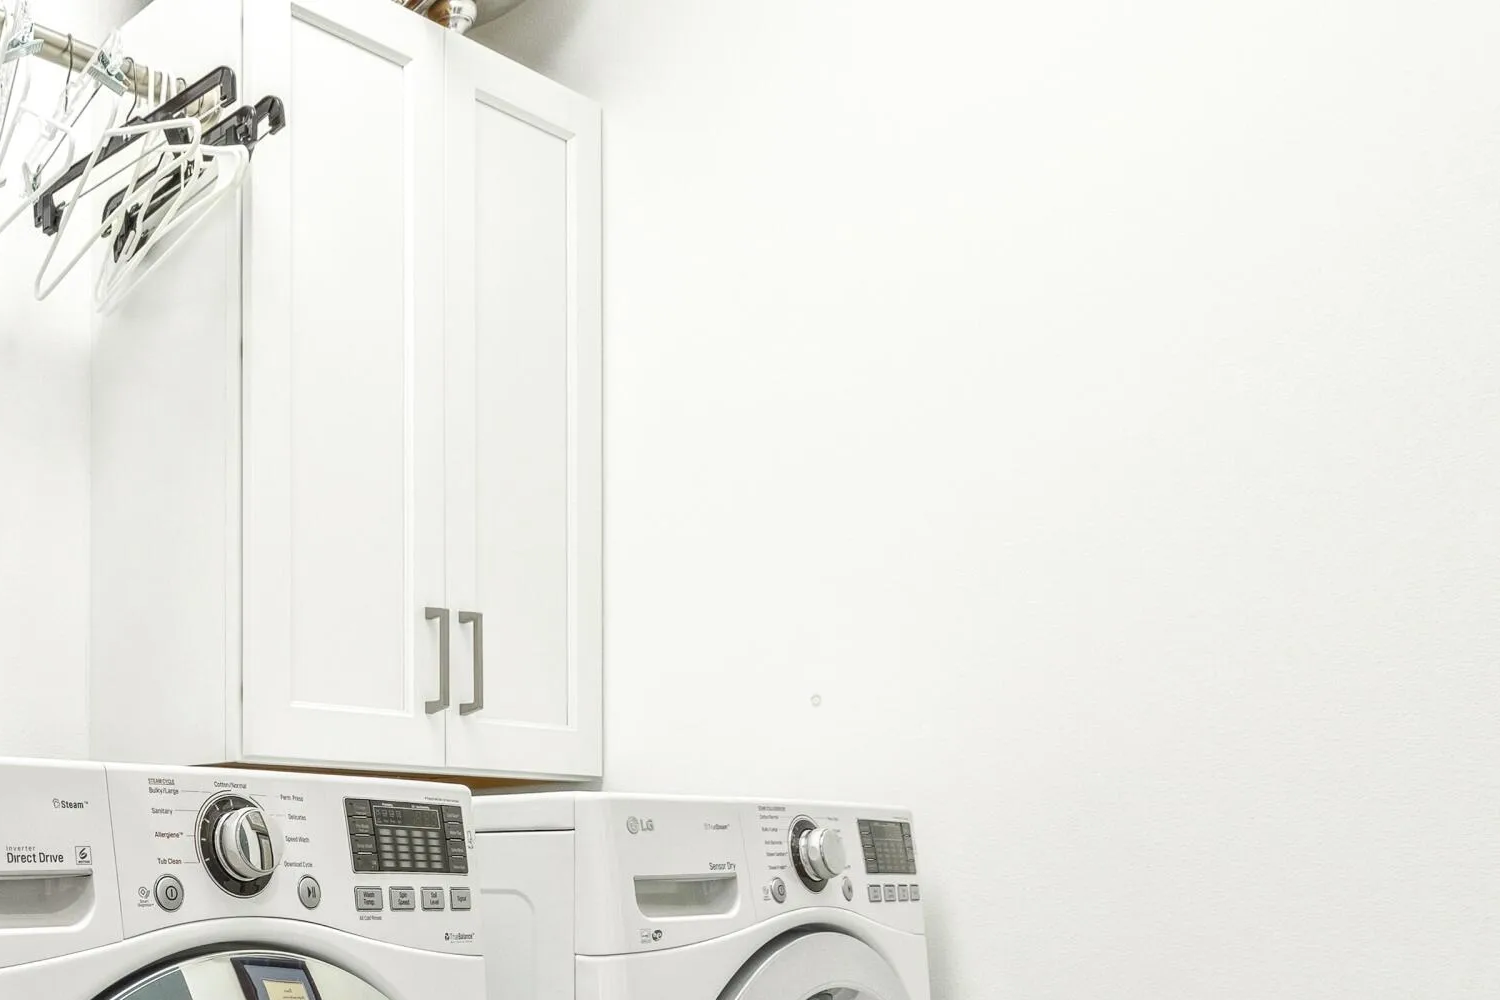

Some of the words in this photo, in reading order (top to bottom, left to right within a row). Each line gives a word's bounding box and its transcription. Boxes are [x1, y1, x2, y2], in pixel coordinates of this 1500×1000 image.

[640, 819, 654, 831] LG
[6, 852, 37, 864] Direct
[38, 852, 64, 864] Drive
[709, 862, 726, 871] Sensor
[726, 862, 736, 871] Dry
